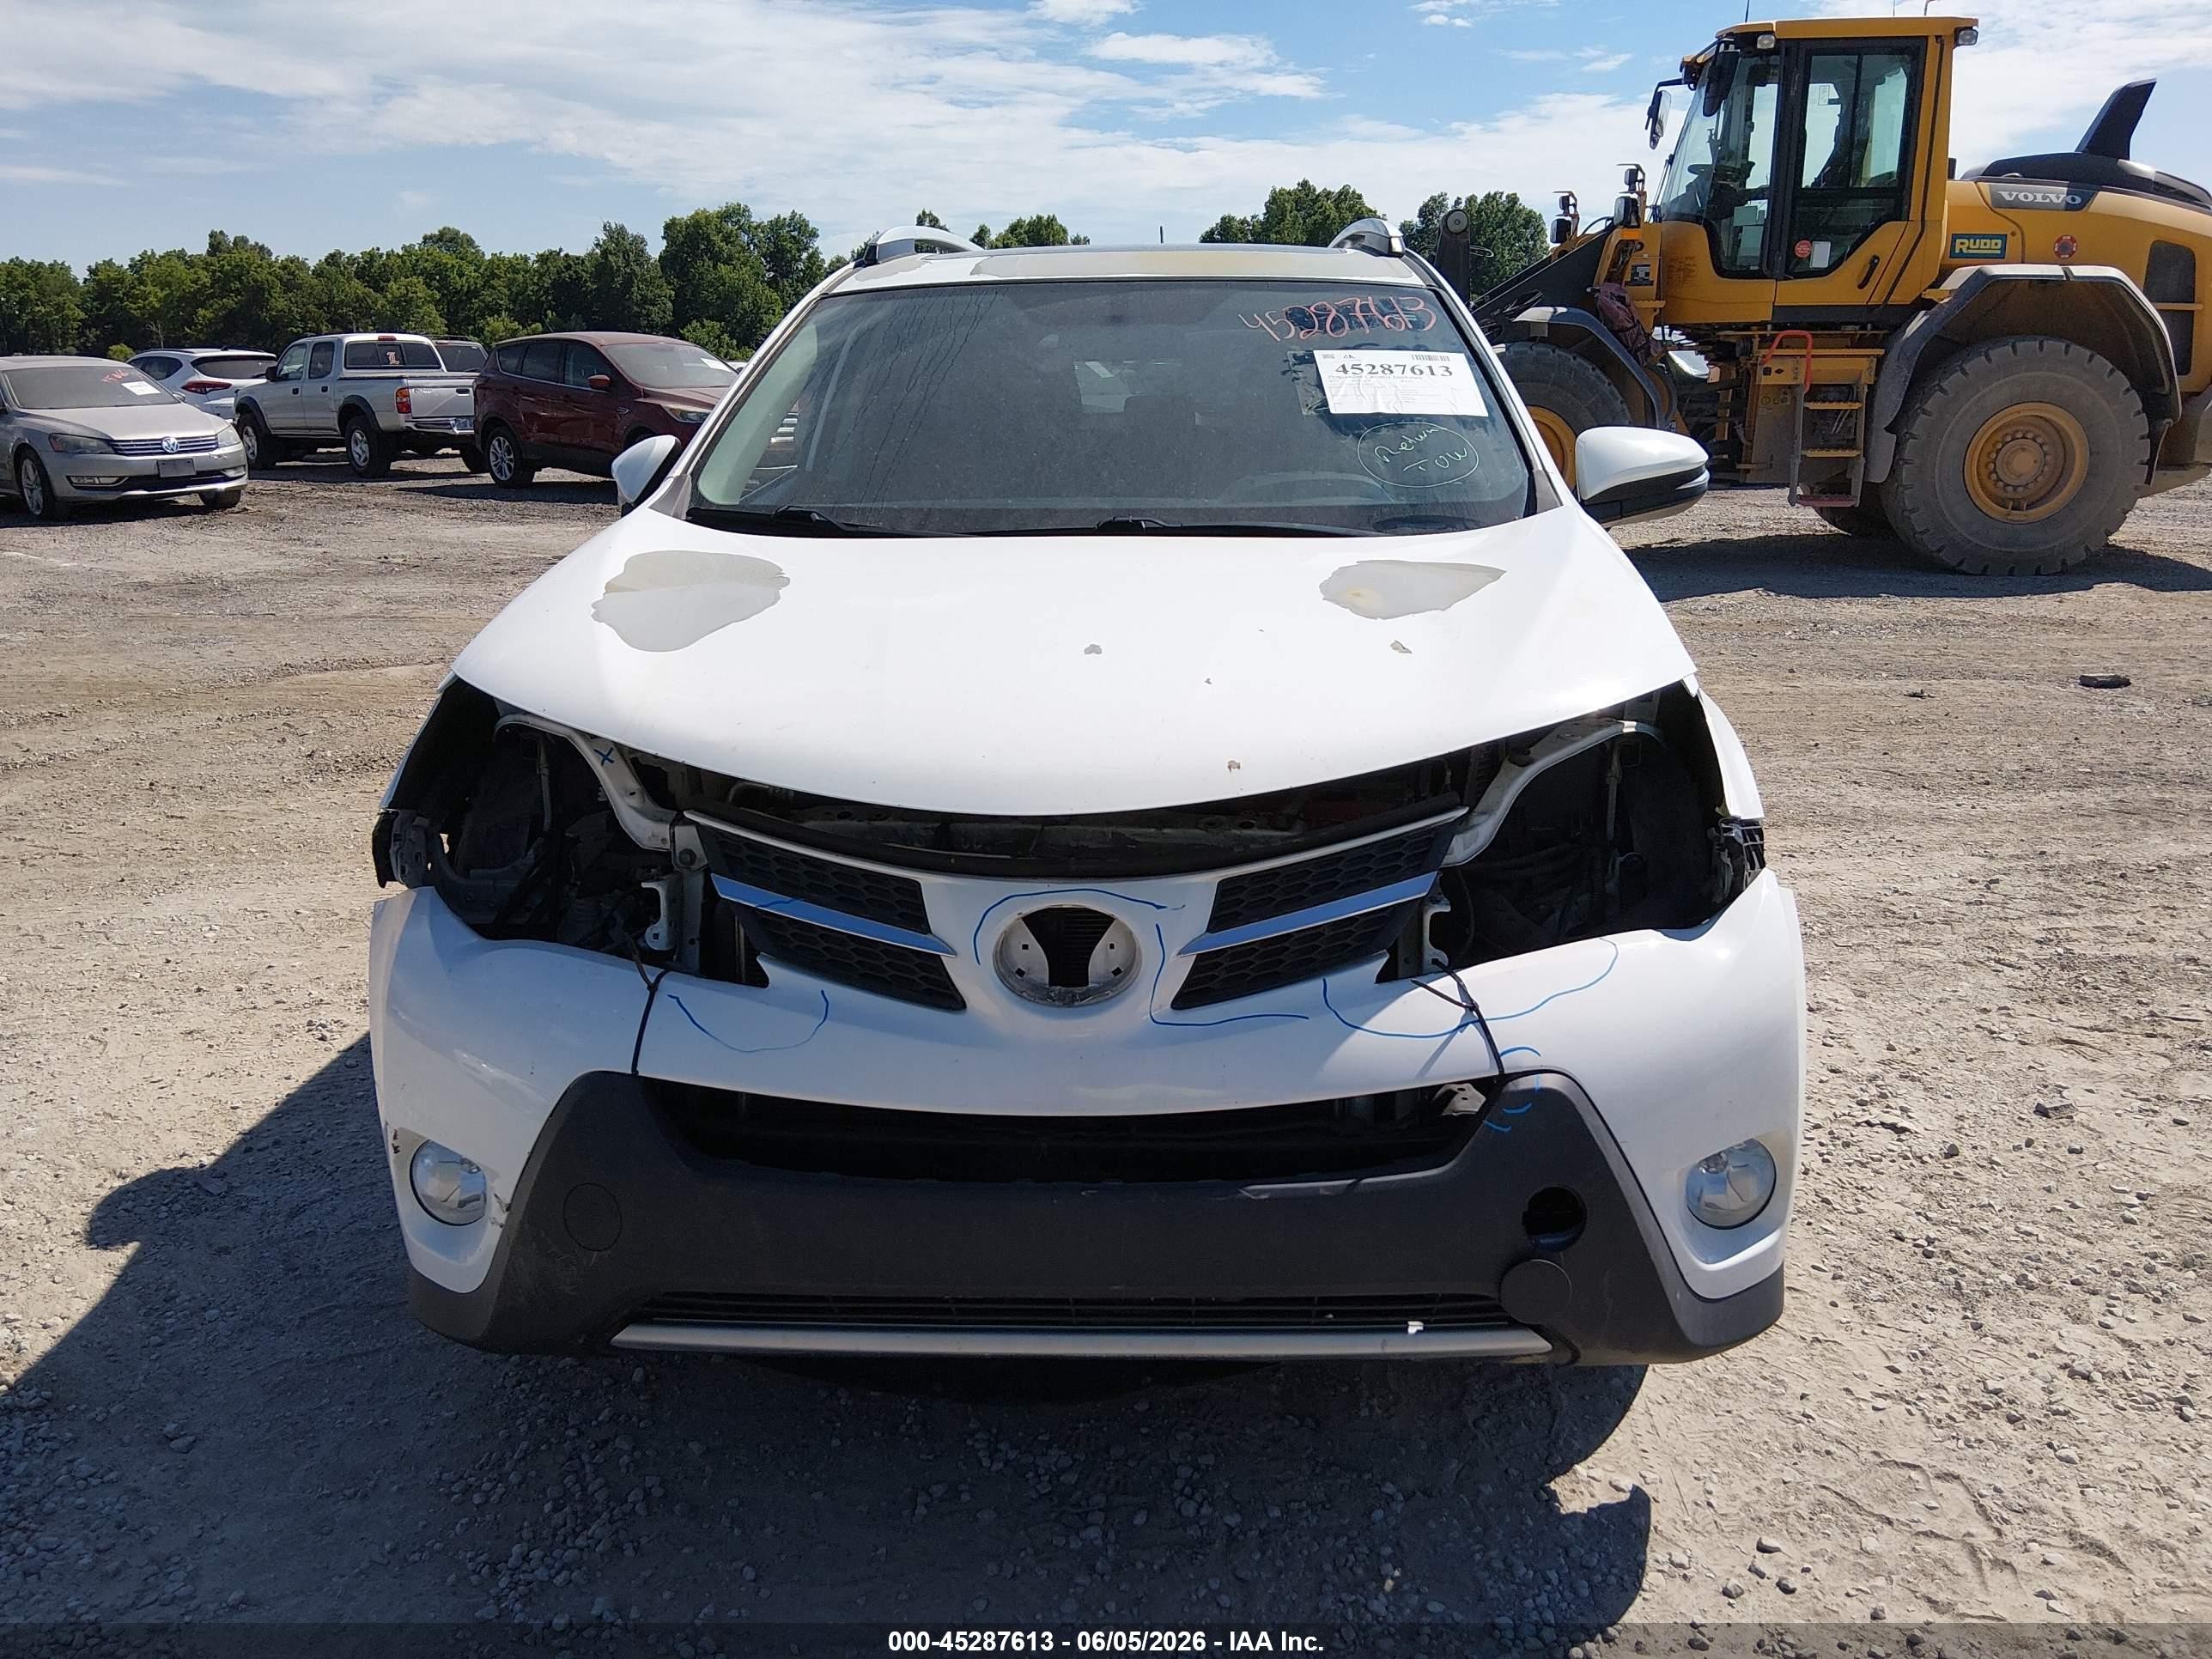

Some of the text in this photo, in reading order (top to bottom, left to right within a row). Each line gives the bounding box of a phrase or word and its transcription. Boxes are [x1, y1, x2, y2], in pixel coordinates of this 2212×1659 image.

[1998, 191, 2082, 204] VOLVO
[1955, 238, 2002, 254] RUDD
[1334, 362, 1454, 377] 45287613
